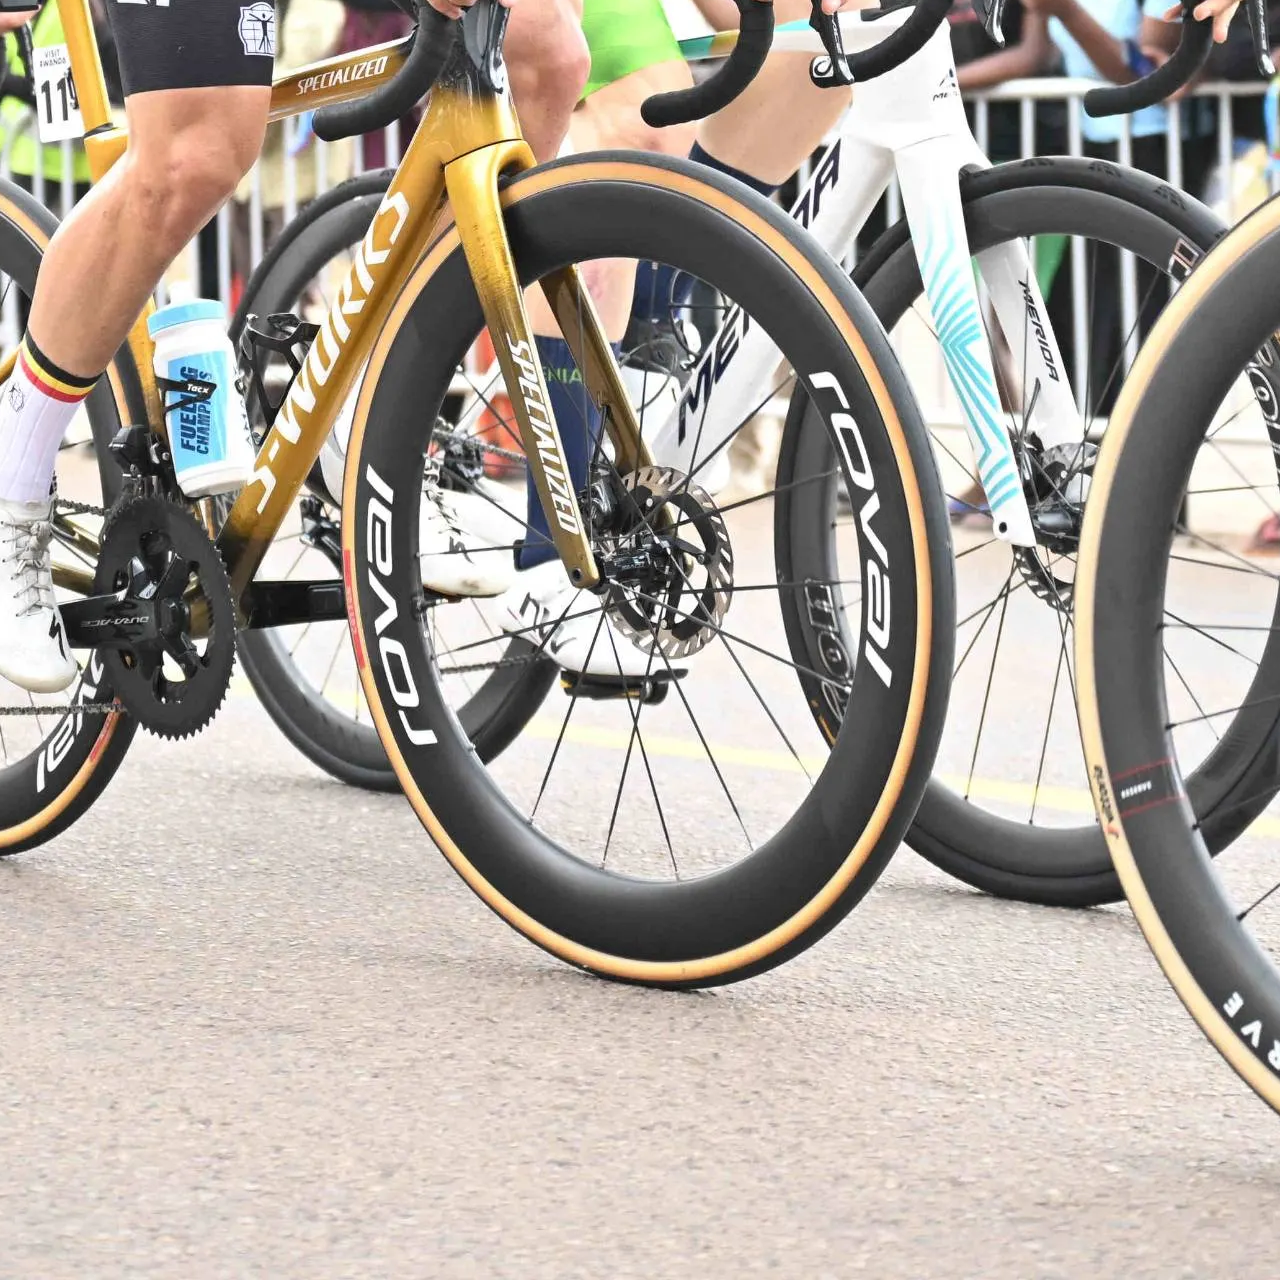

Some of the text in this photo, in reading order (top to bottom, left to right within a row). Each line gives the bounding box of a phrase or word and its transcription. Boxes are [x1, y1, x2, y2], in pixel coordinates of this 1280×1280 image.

[45, 49, 60, 59] VISIT
[296, 56, 389, 95] SPECIALIZED
[187, 383, 210, 394] Tacx
[247, 191, 410, 515] S-WORKS
[1018, 279, 1060, 383] MERIDA
[506, 331, 580, 535] SPECIALIZED
[366, 463, 438, 746] roval
[806, 369, 894, 689] roval
